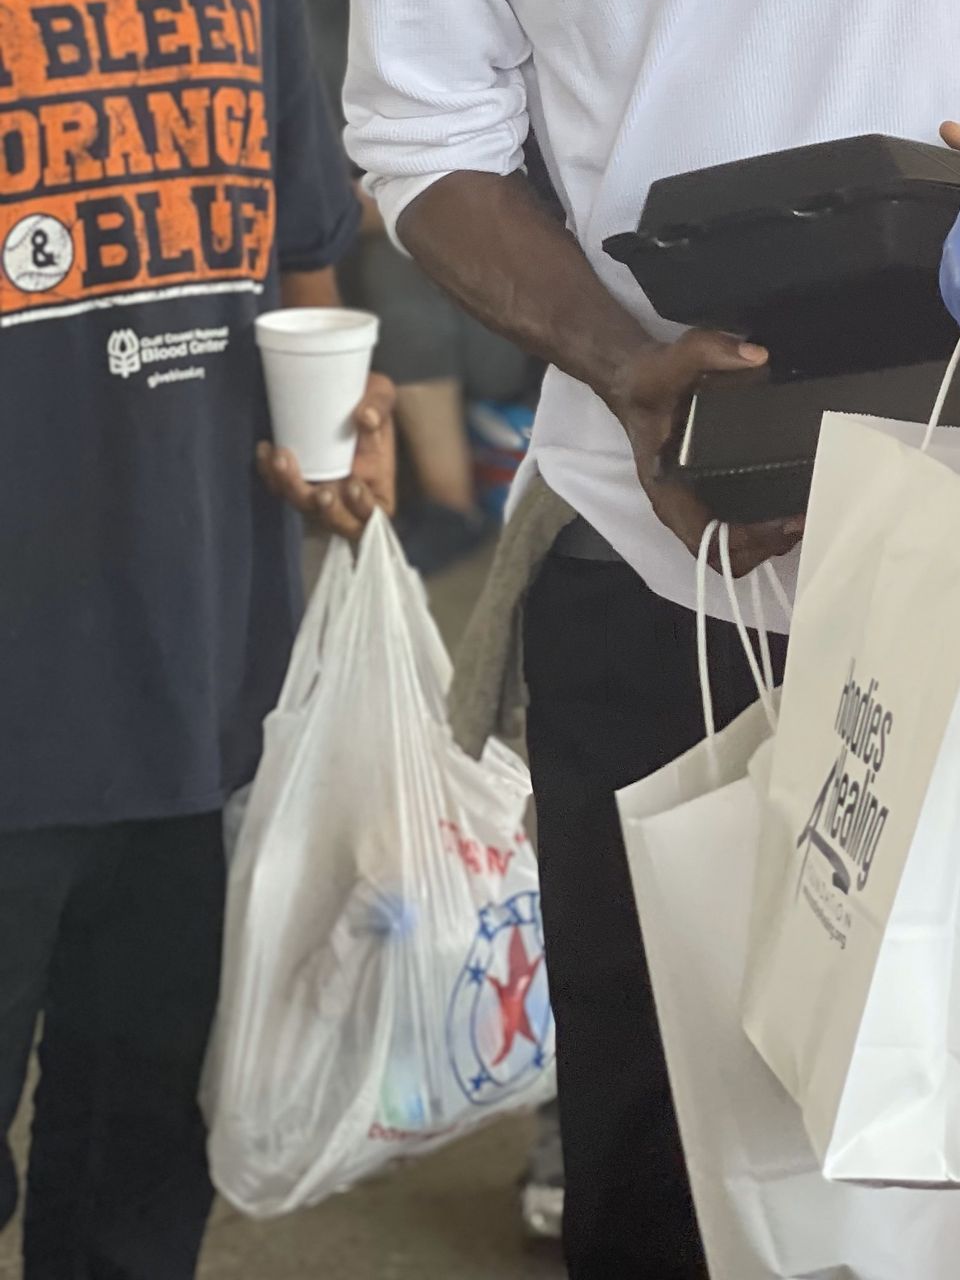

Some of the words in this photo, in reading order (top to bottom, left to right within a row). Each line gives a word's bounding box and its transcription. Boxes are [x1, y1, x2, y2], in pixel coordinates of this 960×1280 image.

[31, 229, 58, 267] &
[141, 341, 188, 363] Blood
[824, 744, 889, 891] Healing
